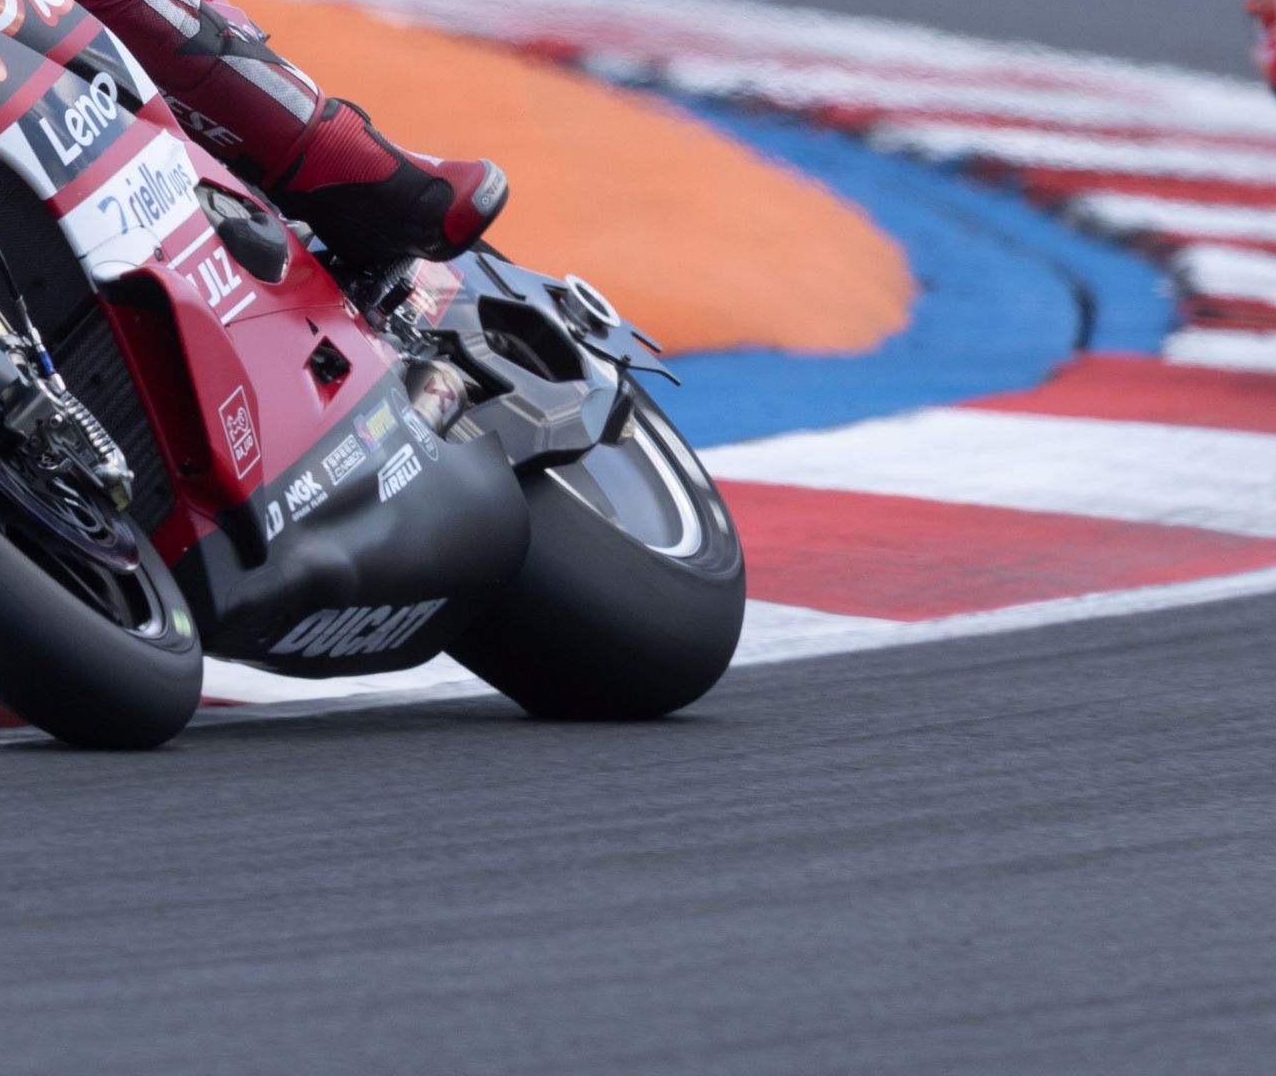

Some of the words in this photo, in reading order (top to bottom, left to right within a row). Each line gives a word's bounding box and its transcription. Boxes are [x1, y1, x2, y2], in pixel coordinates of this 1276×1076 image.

[38, 71, 118, 167] Leno
[126, 162, 170, 228] riello
[167, 162, 193, 203] ups
[284, 470, 324, 512] NGK
[377, 443, 423, 503] PIRELLI
[267, 596, 449, 658] DUCATI
